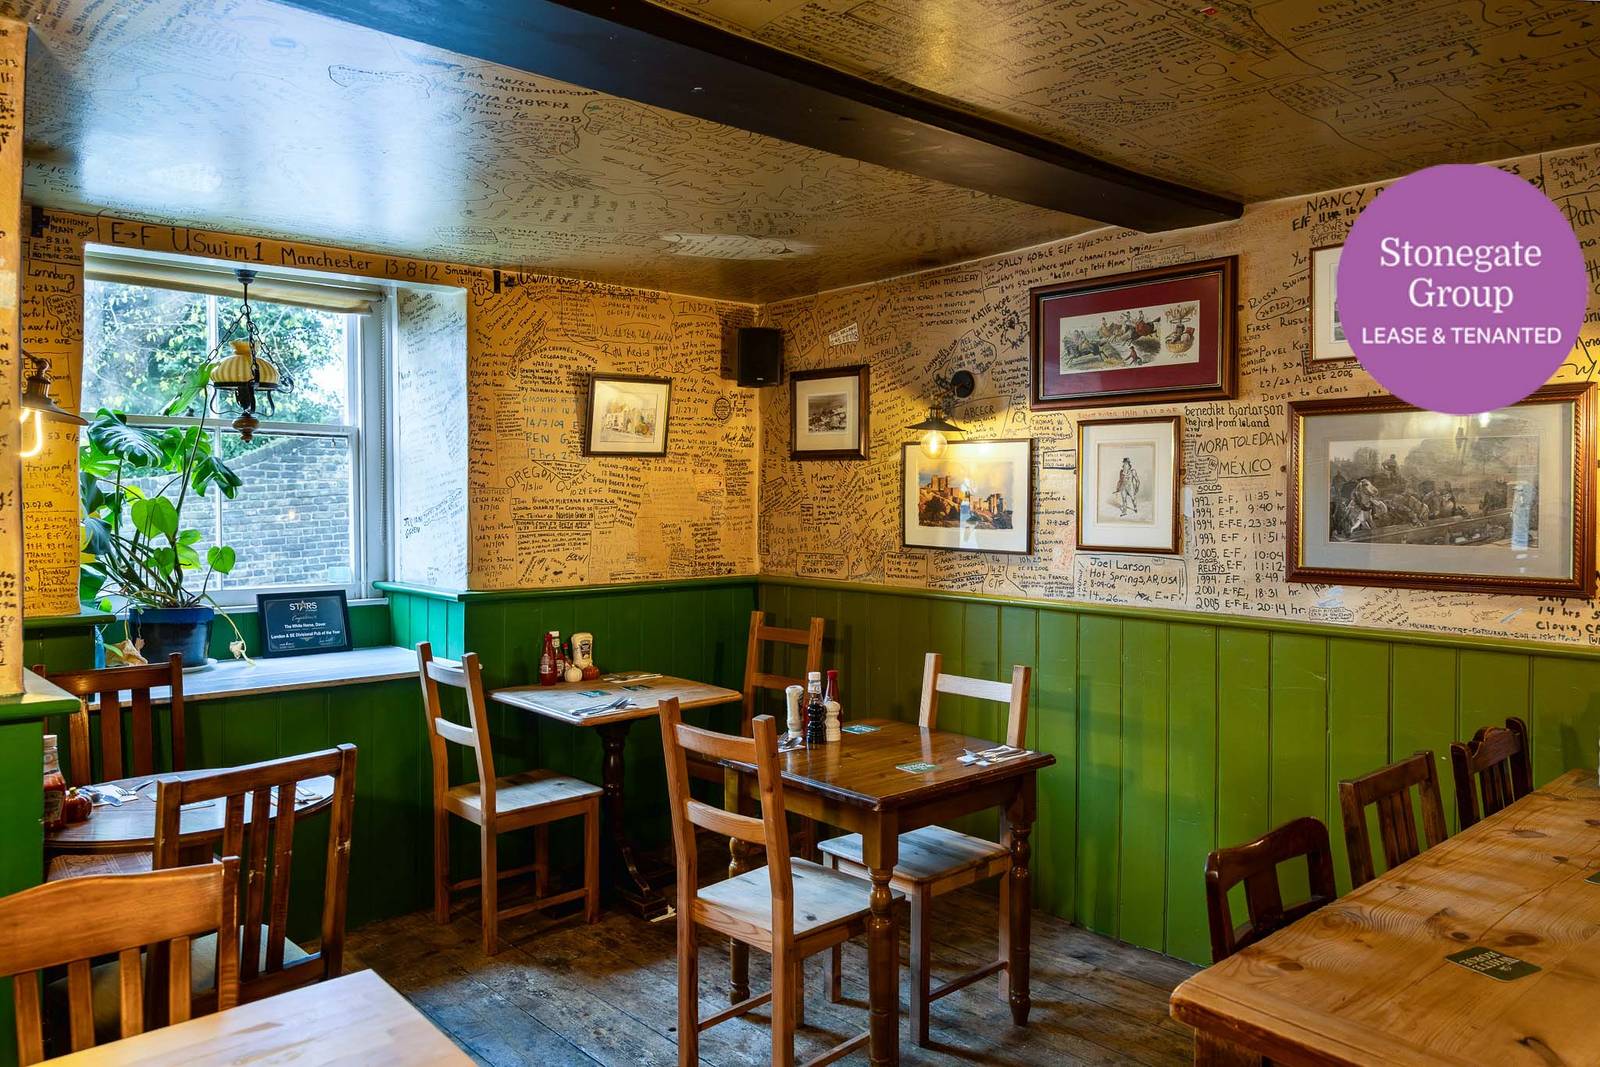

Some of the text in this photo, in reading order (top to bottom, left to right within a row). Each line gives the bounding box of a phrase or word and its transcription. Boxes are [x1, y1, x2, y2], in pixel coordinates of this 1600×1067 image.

[1306, 189, 1365, 216] NANCY
[281, 246, 375, 270] Manchester
[997, 256, 1024, 272] SALLY
[678, 300, 714, 314] INDIA
[971, 295, 1011, 324] KATIE HOPE
[1246, 322, 1272, 335] First
[1293, 373, 1327, 385] August
[1316, 385, 1349, 396] Calais
[1215, 417, 1237, 430] from
[525, 432, 550, 444] BEN
[1197, 437, 1229, 454] NORA
[505, 466, 556, 489] OREGON
[1090, 557, 1151, 573] Joel Larson
[1089, 569, 1107, 579] Hot
[289, 600, 318, 612] STARS
[1562, 608, 1580, 619] hrs
